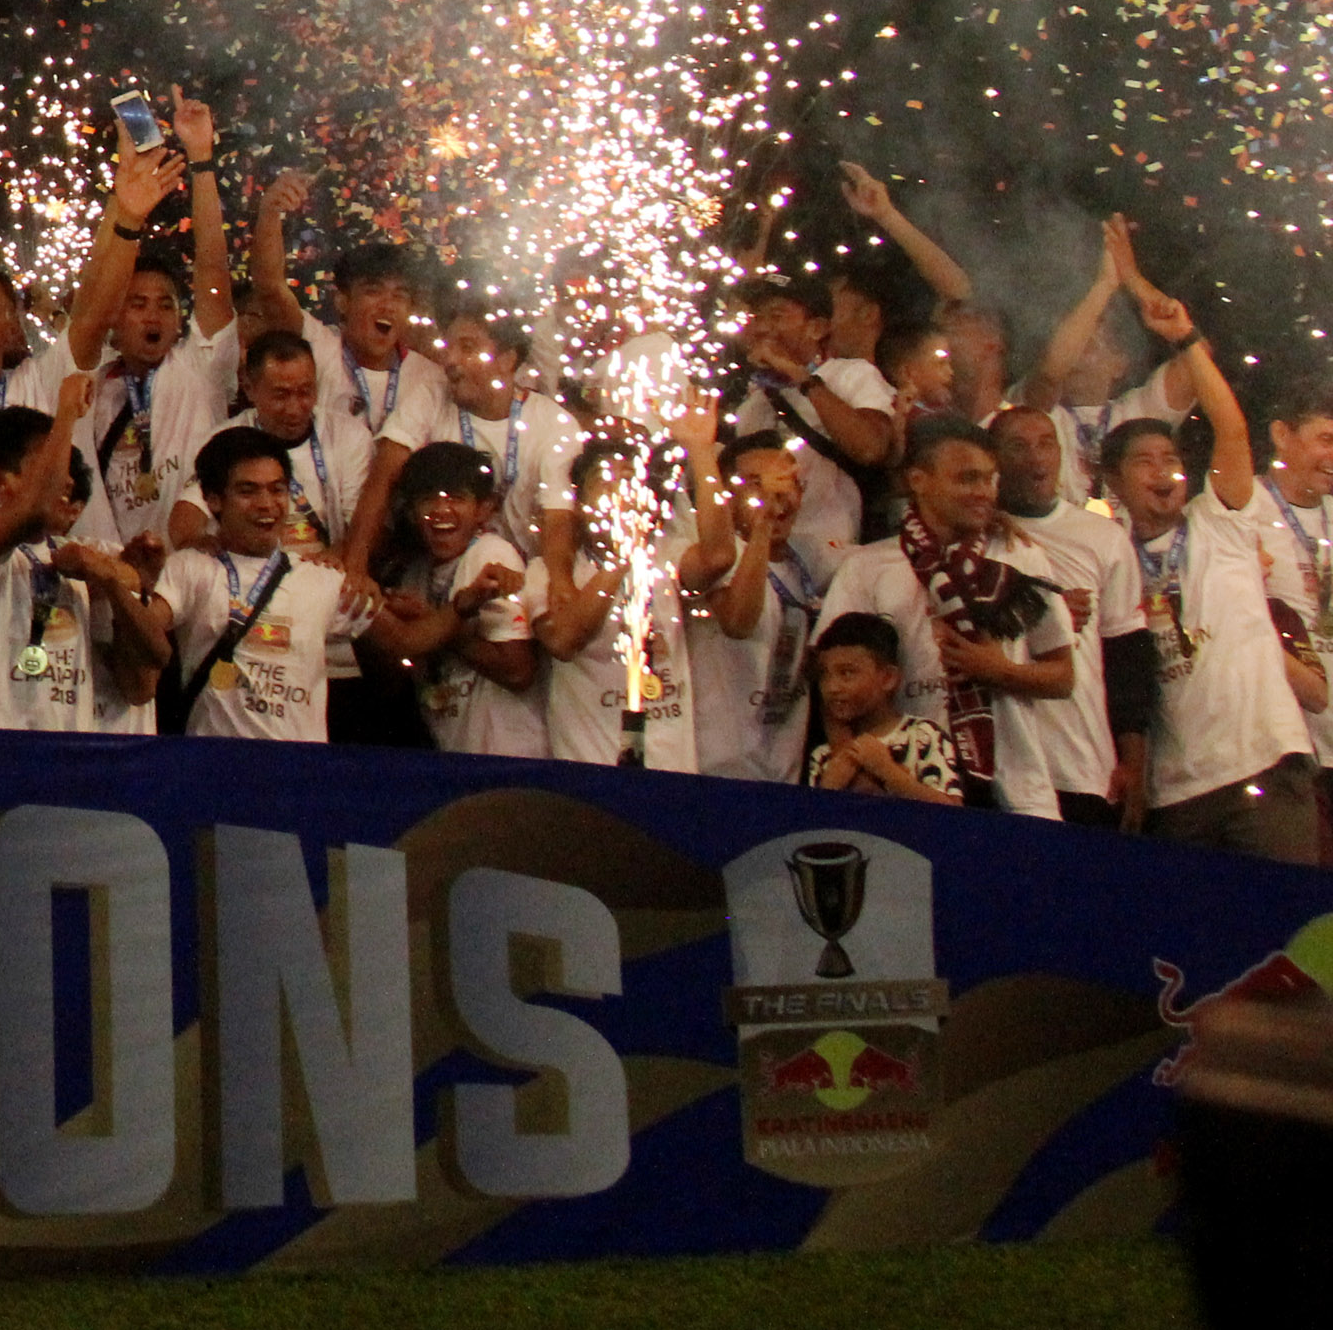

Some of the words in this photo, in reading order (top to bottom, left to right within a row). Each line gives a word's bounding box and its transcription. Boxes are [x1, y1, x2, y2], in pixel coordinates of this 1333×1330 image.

[247, 662, 286, 680] THE
[245, 697, 286, 717] 2018
[744, 995, 806, 1015] THE
